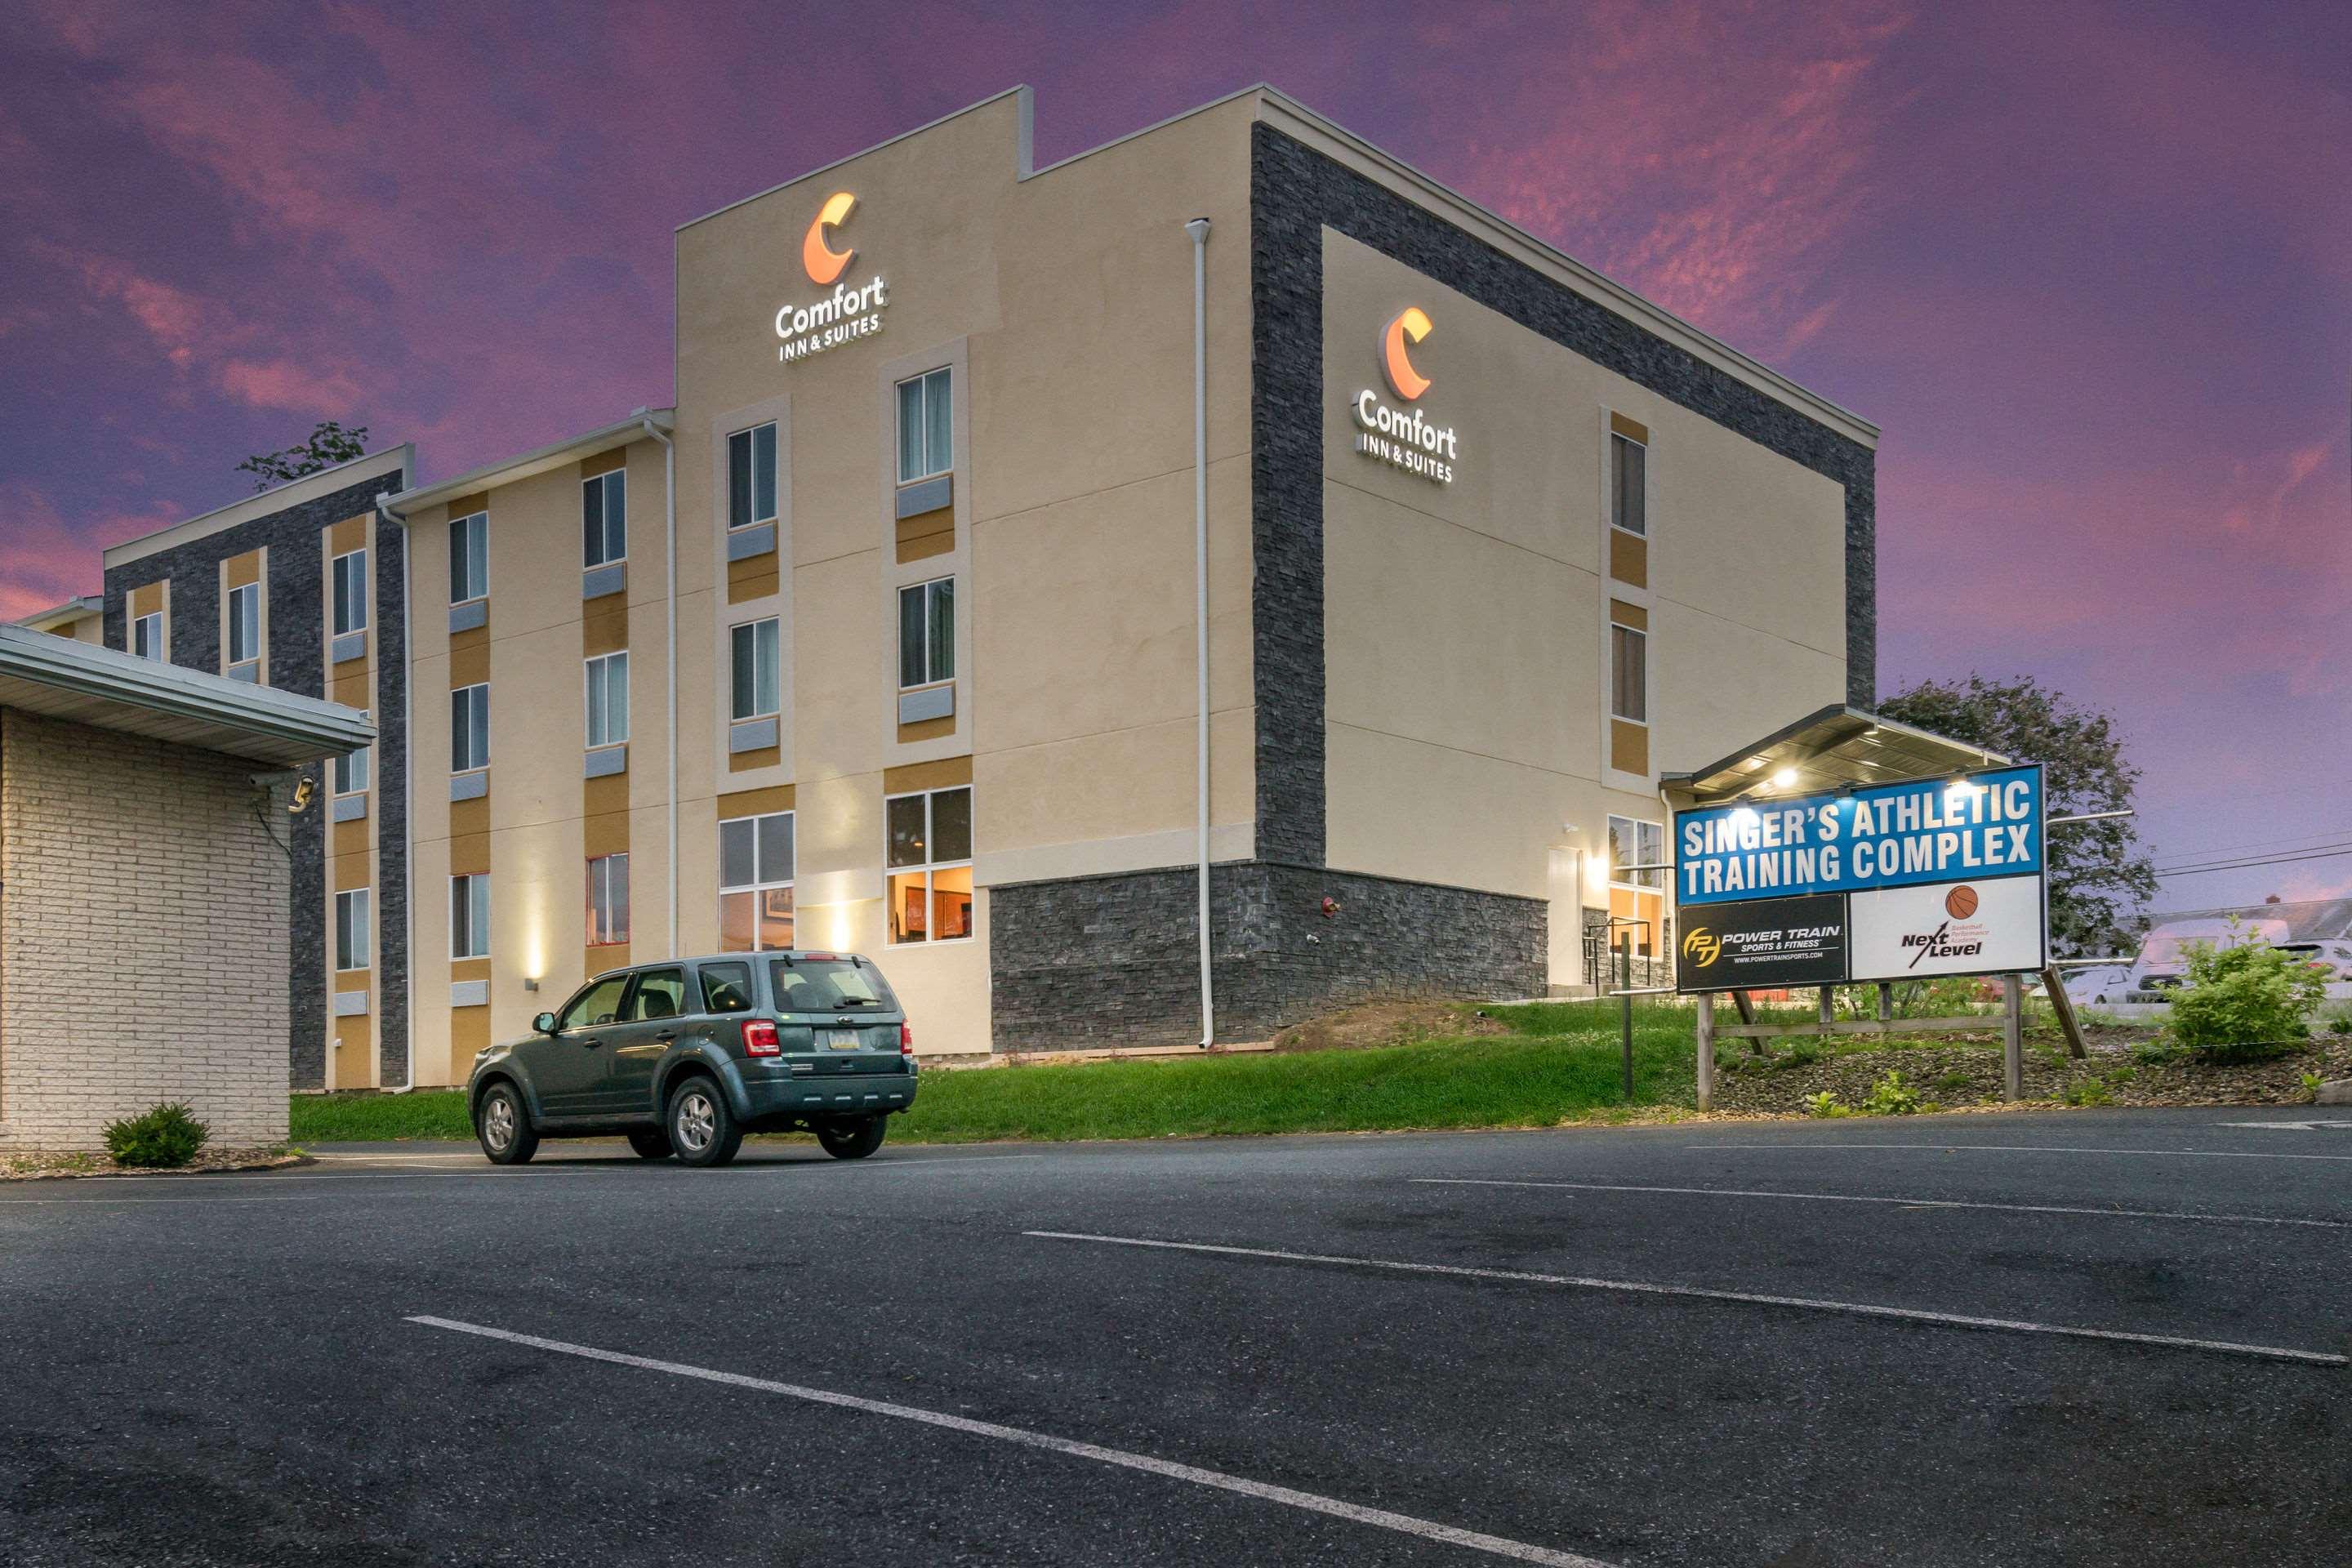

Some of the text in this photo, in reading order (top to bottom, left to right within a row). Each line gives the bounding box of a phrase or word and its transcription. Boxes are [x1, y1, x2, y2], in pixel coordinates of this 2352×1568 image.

[775, 275, 884, 339] Comfort
[1358, 389, 1457, 460] Comfort
[1684, 780, 2029, 857] SINGER'S ATHLETIC
[1684, 823, 2031, 895] TRAINING COMPLEX
[1722, 925, 1841, 945] POWER TRAIN
[1901, 933, 1949, 947] Next
[1741, 939, 1820, 952] SPORTS & FITNESS
[1929, 942, 1983, 957] Level
[1734, 952, 1823, 964] WWW.POWERTRAINSPORTS.COM
